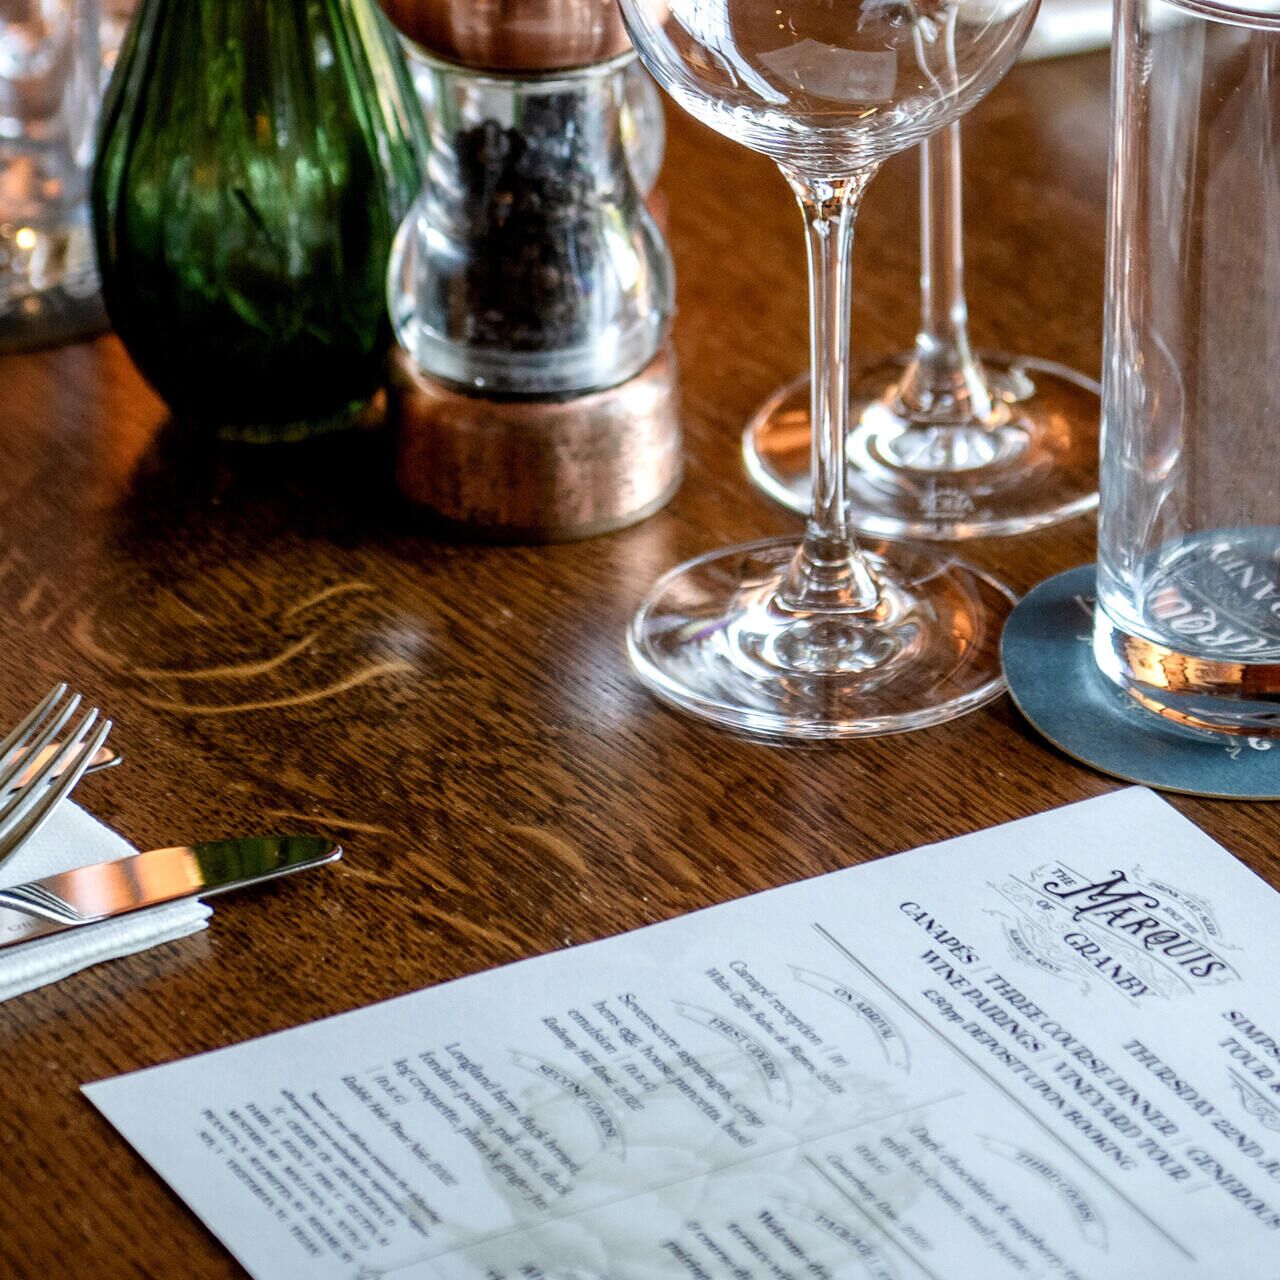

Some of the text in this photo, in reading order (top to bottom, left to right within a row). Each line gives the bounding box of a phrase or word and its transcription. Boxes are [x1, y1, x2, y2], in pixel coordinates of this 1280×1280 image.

[1033, 897, 1058, 912] OF
[1048, 865, 1079, 888] THE
[1042, 867, 1228, 983] MARQUIS
[1061, 930, 1156, 999] GRANBY
[565, 1007, 619, 1056] emulsion
[726, 958, 778, 1000] Canapé
[766, 996, 824, 1047] reception
[851, 999, 897, 1041] ARRIVAL
[897, 899, 981, 965] CANAPÉS
[982, 971, 1050, 1023] THREE
[1037, 1019, 1116, 1079] COURSE
[1103, 1074, 1180, 1138] DINNER
[615, 990, 682, 1051] Sevenscore
[727, 1100, 767, 1130] crisp
[637, 1043, 677, 1079] house
[918, 947, 1192, 1183] WINE PAIRINGS VINEYARD TOUR
[959, 1019, 1032, 1075] DEPOSIT
[1021, 1068, 1068, 1112] UPON
[1061, 1107, 1133, 1171] BOOKING
[1217, 1034, 1276, 1083] TOUR
[1121, 1037, 1217, 1118] THURSDAY
[1208, 1117, 1266, 1160] 22ND
